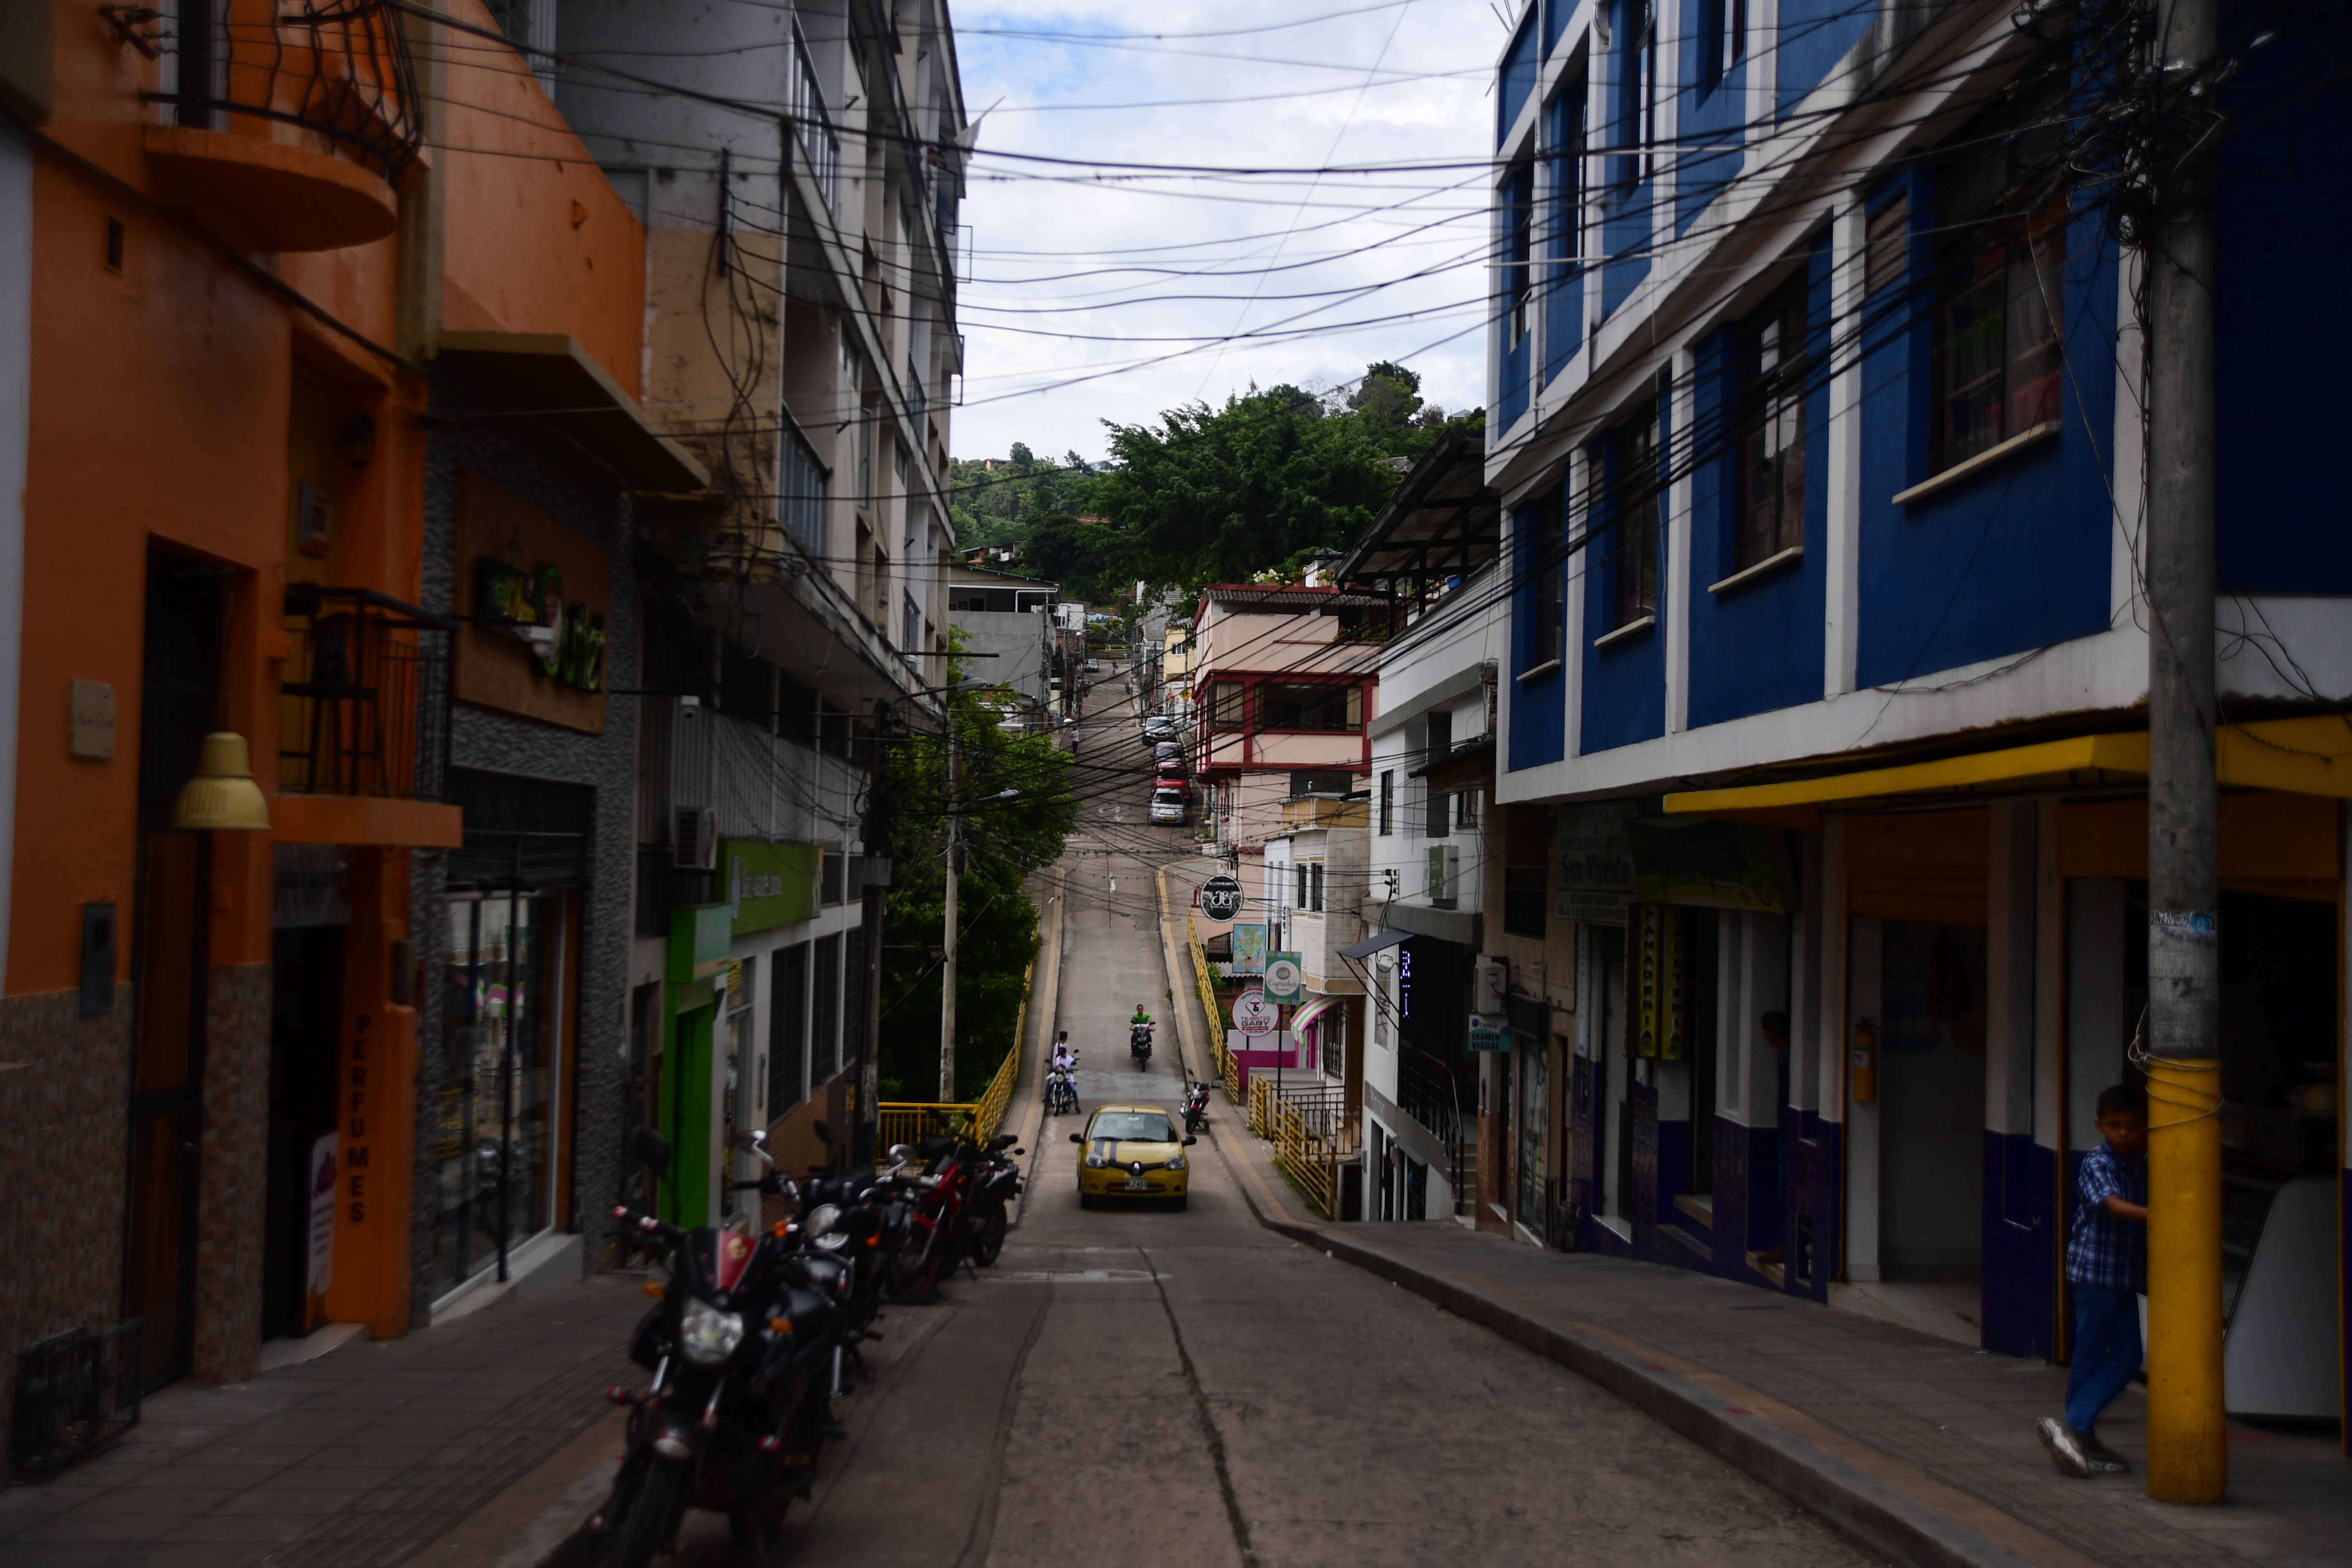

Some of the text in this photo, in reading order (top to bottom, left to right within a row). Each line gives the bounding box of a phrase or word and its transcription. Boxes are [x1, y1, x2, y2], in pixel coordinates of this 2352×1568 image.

[1563, 853, 1629, 884] San Vicente
[1640, 908, 1654, 1039] PANADERIA
[1670, 910, 1683, 1041] CAFETERIA
[1472, 1032, 1500, 1040] EXAMEN
[1472, 1041, 1499, 1049] VISUAL
[348, 1014, 371, 1222] PERFUMES
